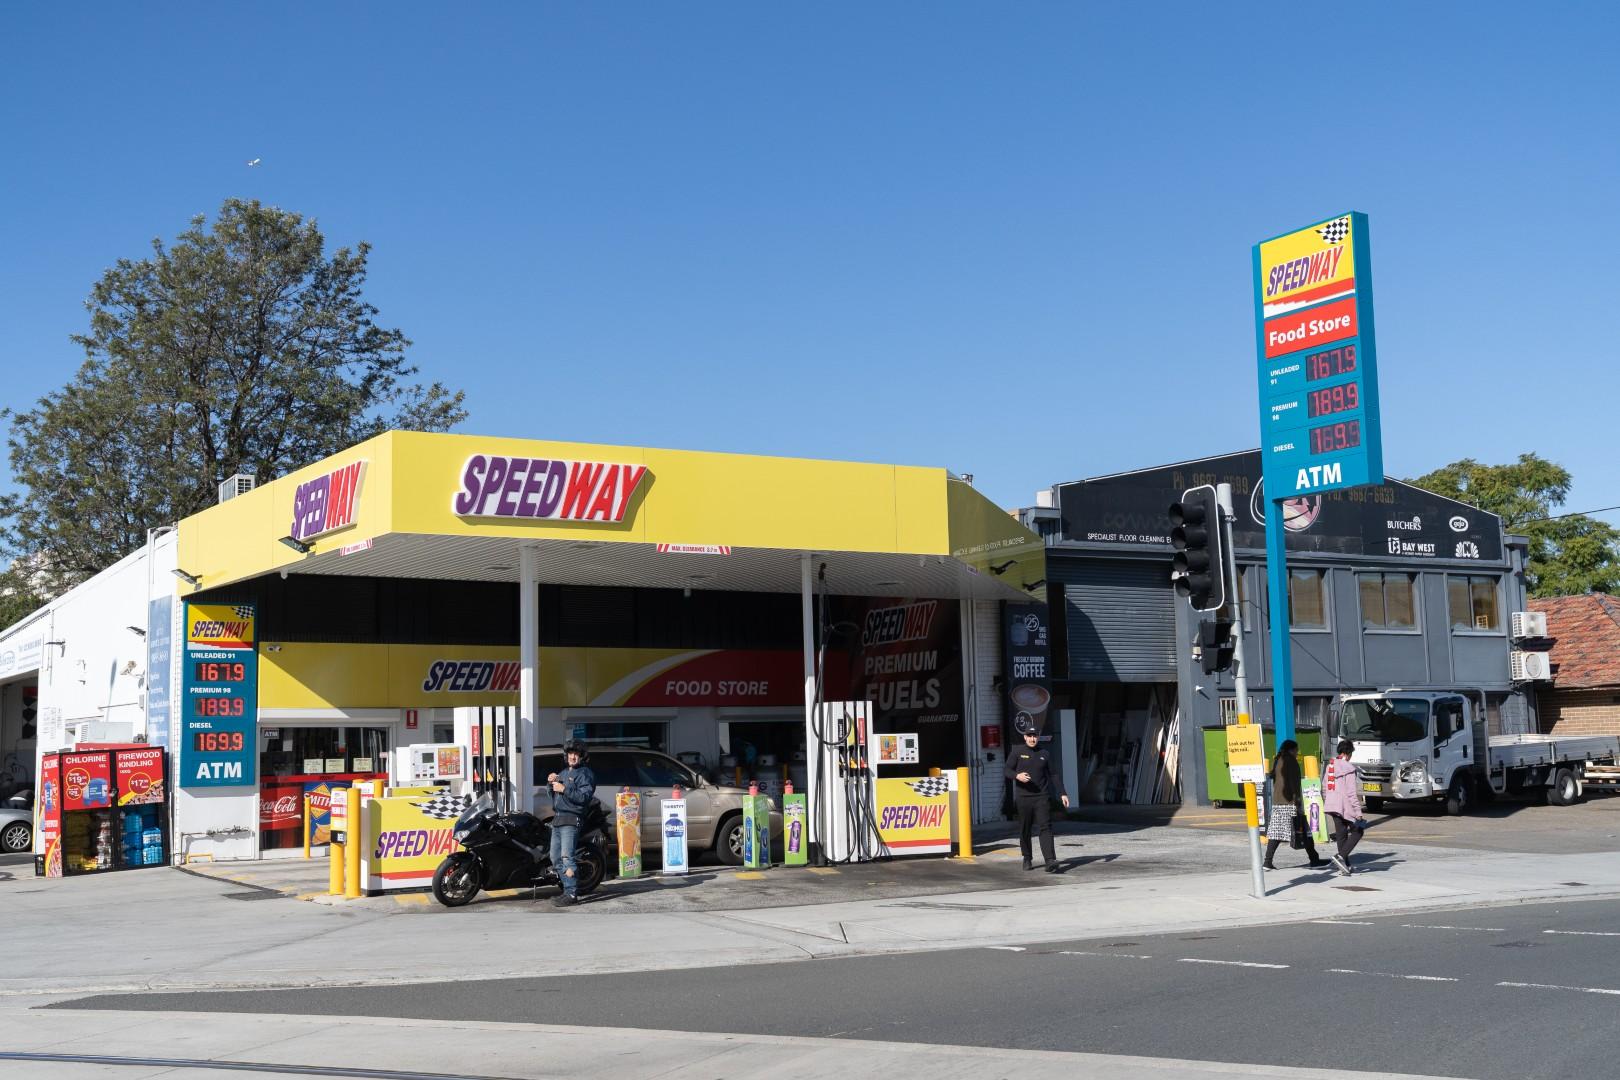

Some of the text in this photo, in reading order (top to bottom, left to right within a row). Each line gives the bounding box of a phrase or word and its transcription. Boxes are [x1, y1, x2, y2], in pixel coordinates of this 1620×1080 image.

[1267, 245, 1343, 296] SPEEDWAY
[1269, 315, 1351, 347] Food Store
[1270, 364, 1300, 377] UNLEADED
[1311, 345, 1356, 380] 167.9
[1270, 378, 1278, 386] 91
[1271, 401, 1298, 412] PREMIUM
[1313, 383, 1358, 416] 189.9
[1273, 443, 1295, 453] DIESEL
[1295, 462, 1342, 490] ATM
[456, 455, 647, 522] SPEEDWAY
[291, 461, 362, 540] SPEEDWAY
[1087, 532, 1117, 541] SPECIALIST
[1119, 534, 1137, 542] FLOOR
[1139, 535, 1165, 543] CLEANING
[1402, 542, 1435, 552] BAY WEST
[192, 620, 249, 638] SPEEDWAY
[864, 602, 936, 645] SPEEDWAY
[865, 650, 937, 675] PREMIUM
[1014, 663, 1045, 678] COFFEE
[200, 663, 244, 681] 167.9
[423, 661, 522, 692] SPEEDWA
[666, 680, 768, 696] FOOD STORE
[866, 678, 940, 711] FUELS
[200, 698, 244, 716] 189.9
[917, 714, 959, 723] GUARANTEED
[199, 732, 244, 751] 169.9
[65, 755, 107, 764] CHLORINE
[118, 751, 160, 760] FIREWOOD
[118, 760, 153, 768] KINDLING
[196, 761, 242, 779] ATM
[880, 805, 947, 830] SPEEDWAY
